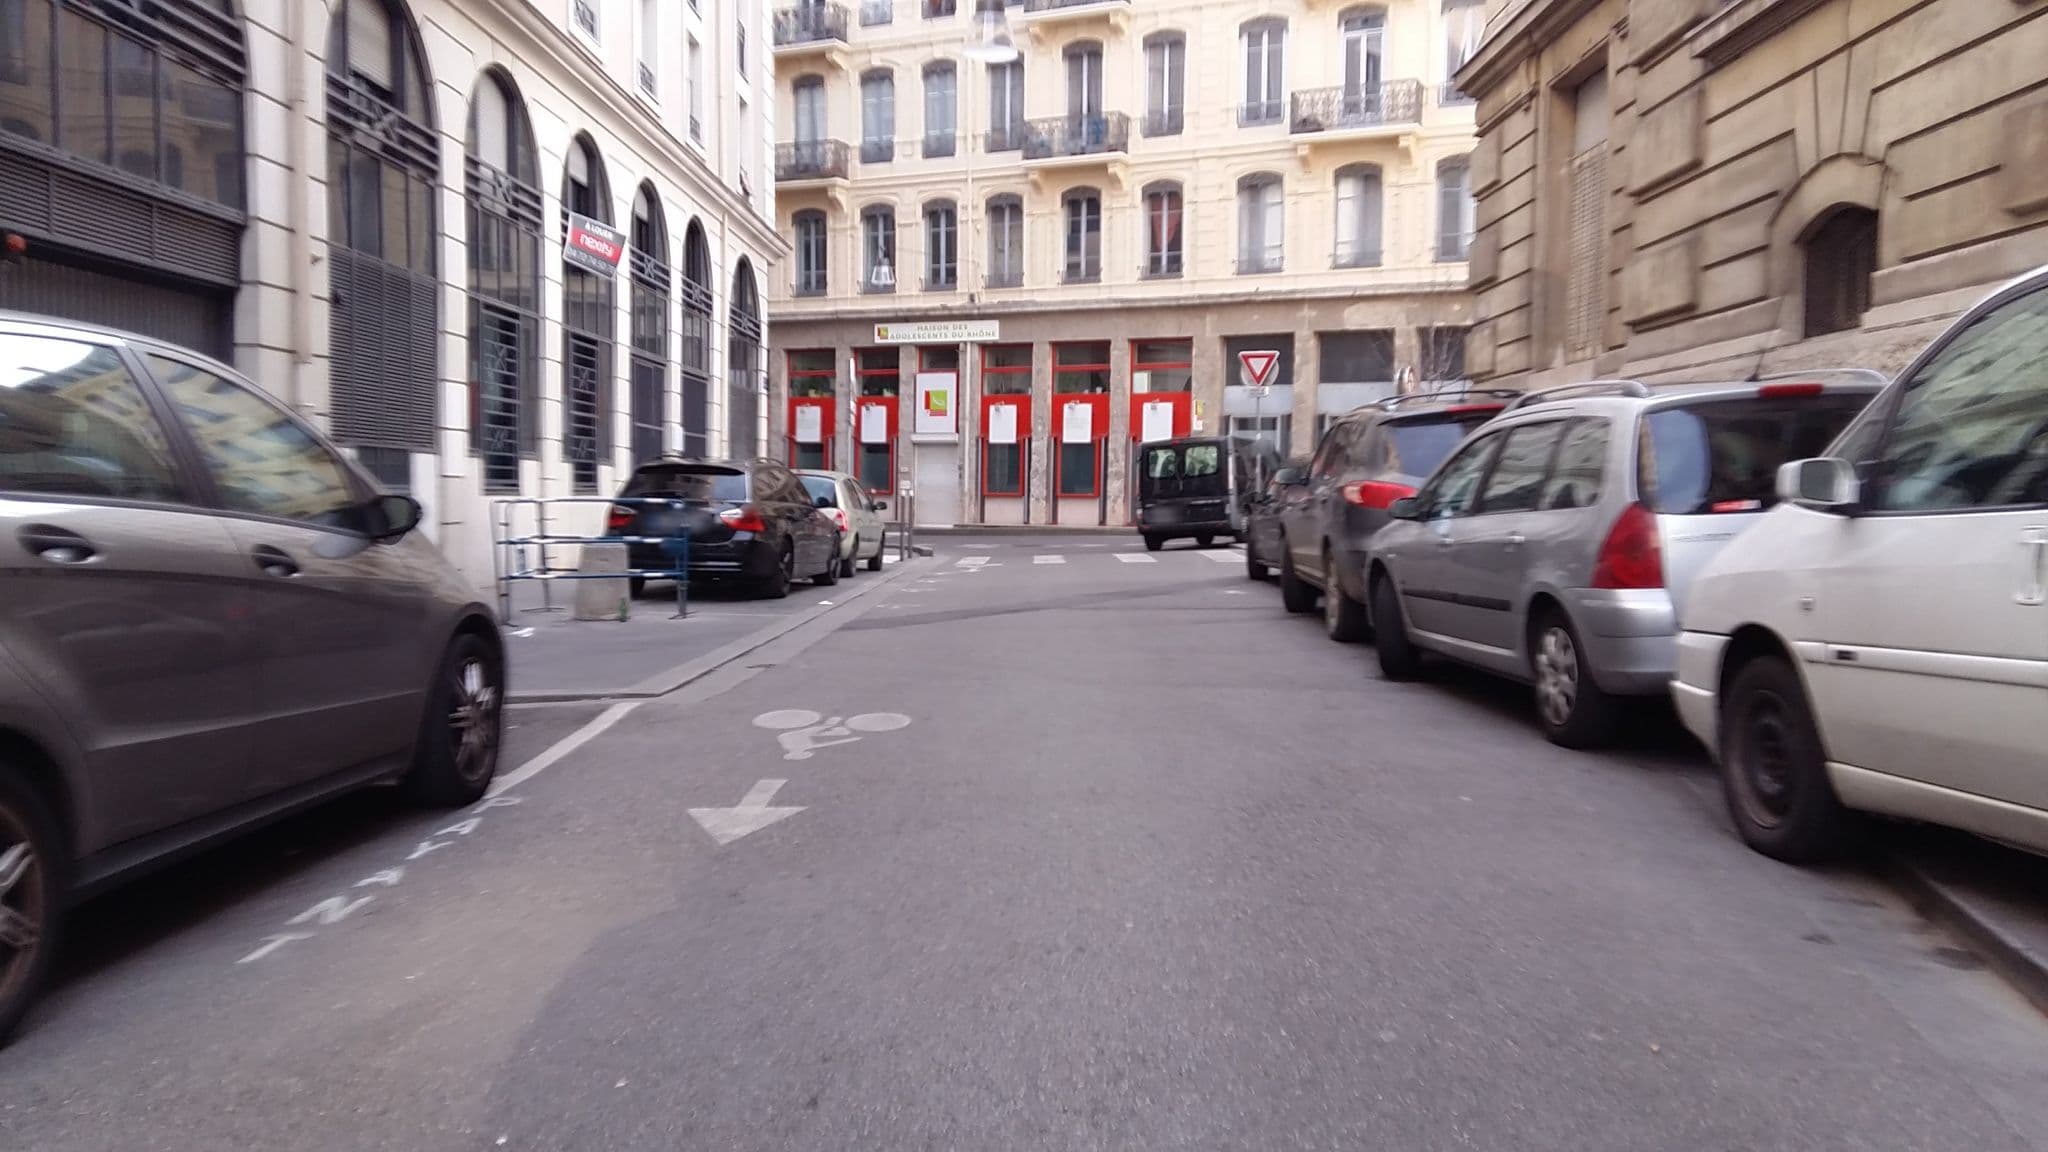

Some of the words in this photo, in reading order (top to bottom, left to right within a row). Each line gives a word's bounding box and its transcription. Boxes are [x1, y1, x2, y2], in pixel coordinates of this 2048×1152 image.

[917, 324, 949, 332] MAISON
[967, 330, 996, 338] RHÔNE
[235, 797, 523, 964] PAYANT
